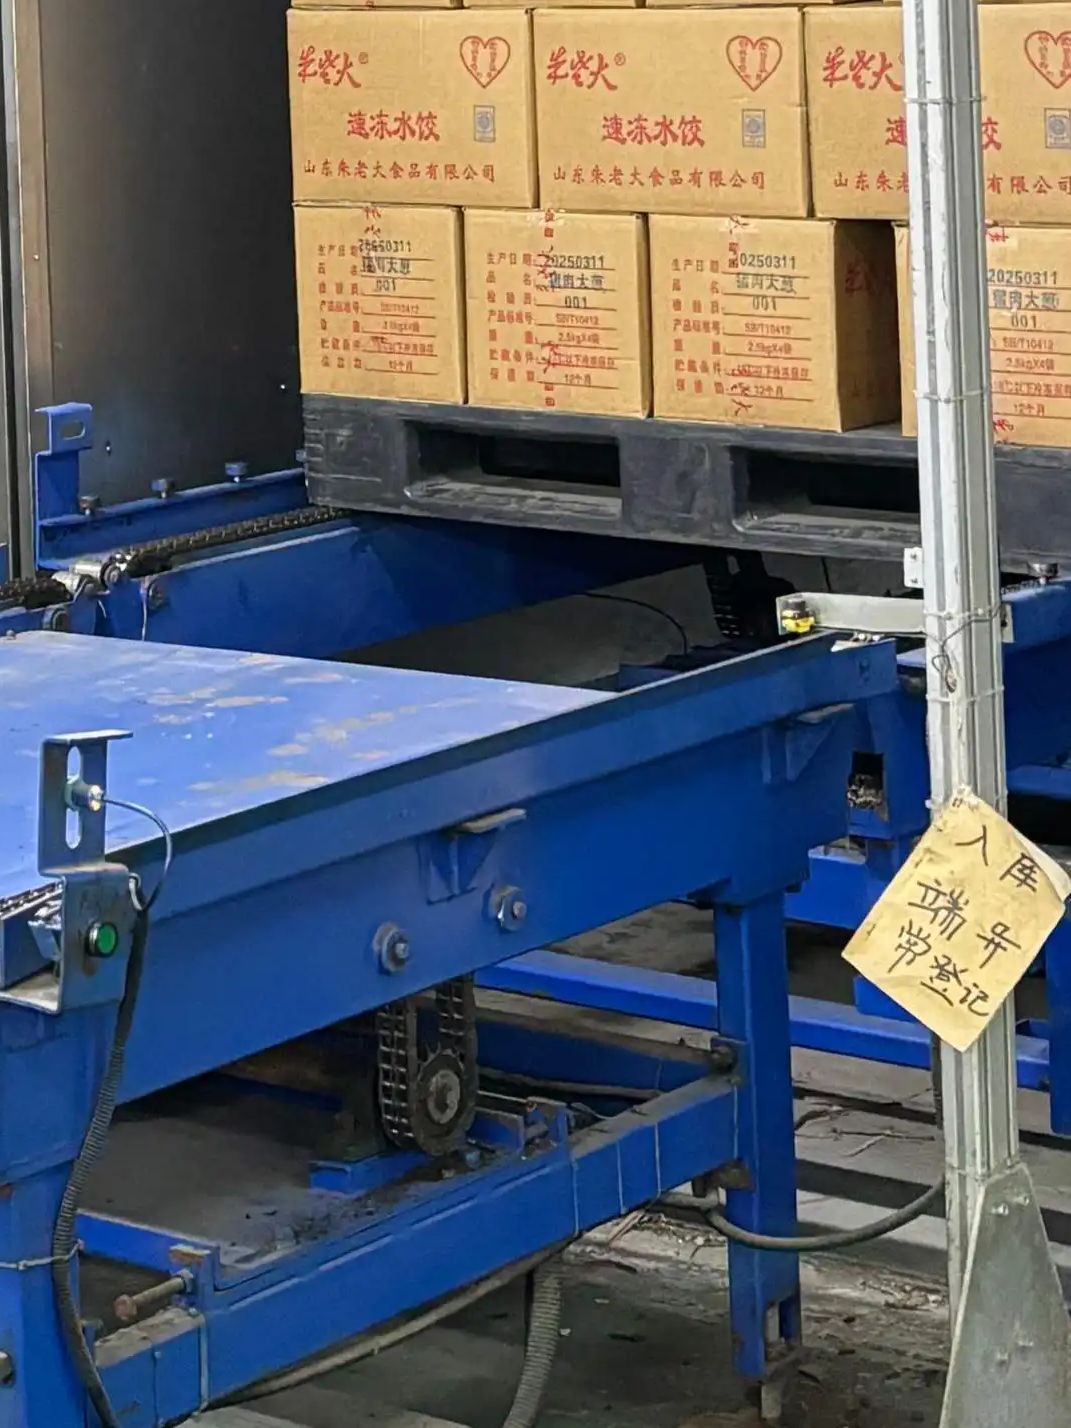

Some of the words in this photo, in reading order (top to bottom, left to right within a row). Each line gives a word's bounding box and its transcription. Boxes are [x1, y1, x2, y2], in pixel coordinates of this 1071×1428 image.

[347, 109, 440, 142] 速冻水饺
[601, 113, 705, 148] 速冻水饺
[303, 158, 495, 183] 山东朱老大食品有限公司
[553, 164, 765, 190] 山东朱老大食品有限公司
[988, 269, 1057, 285] 20250311
[564, 295, 588, 309] 001
[752, 296, 778, 312] 001
[1011, 314, 1037, 329] 001
[1013, 403, 1045, 417] 12个月
[955, 824, 1038, 893] 入库
